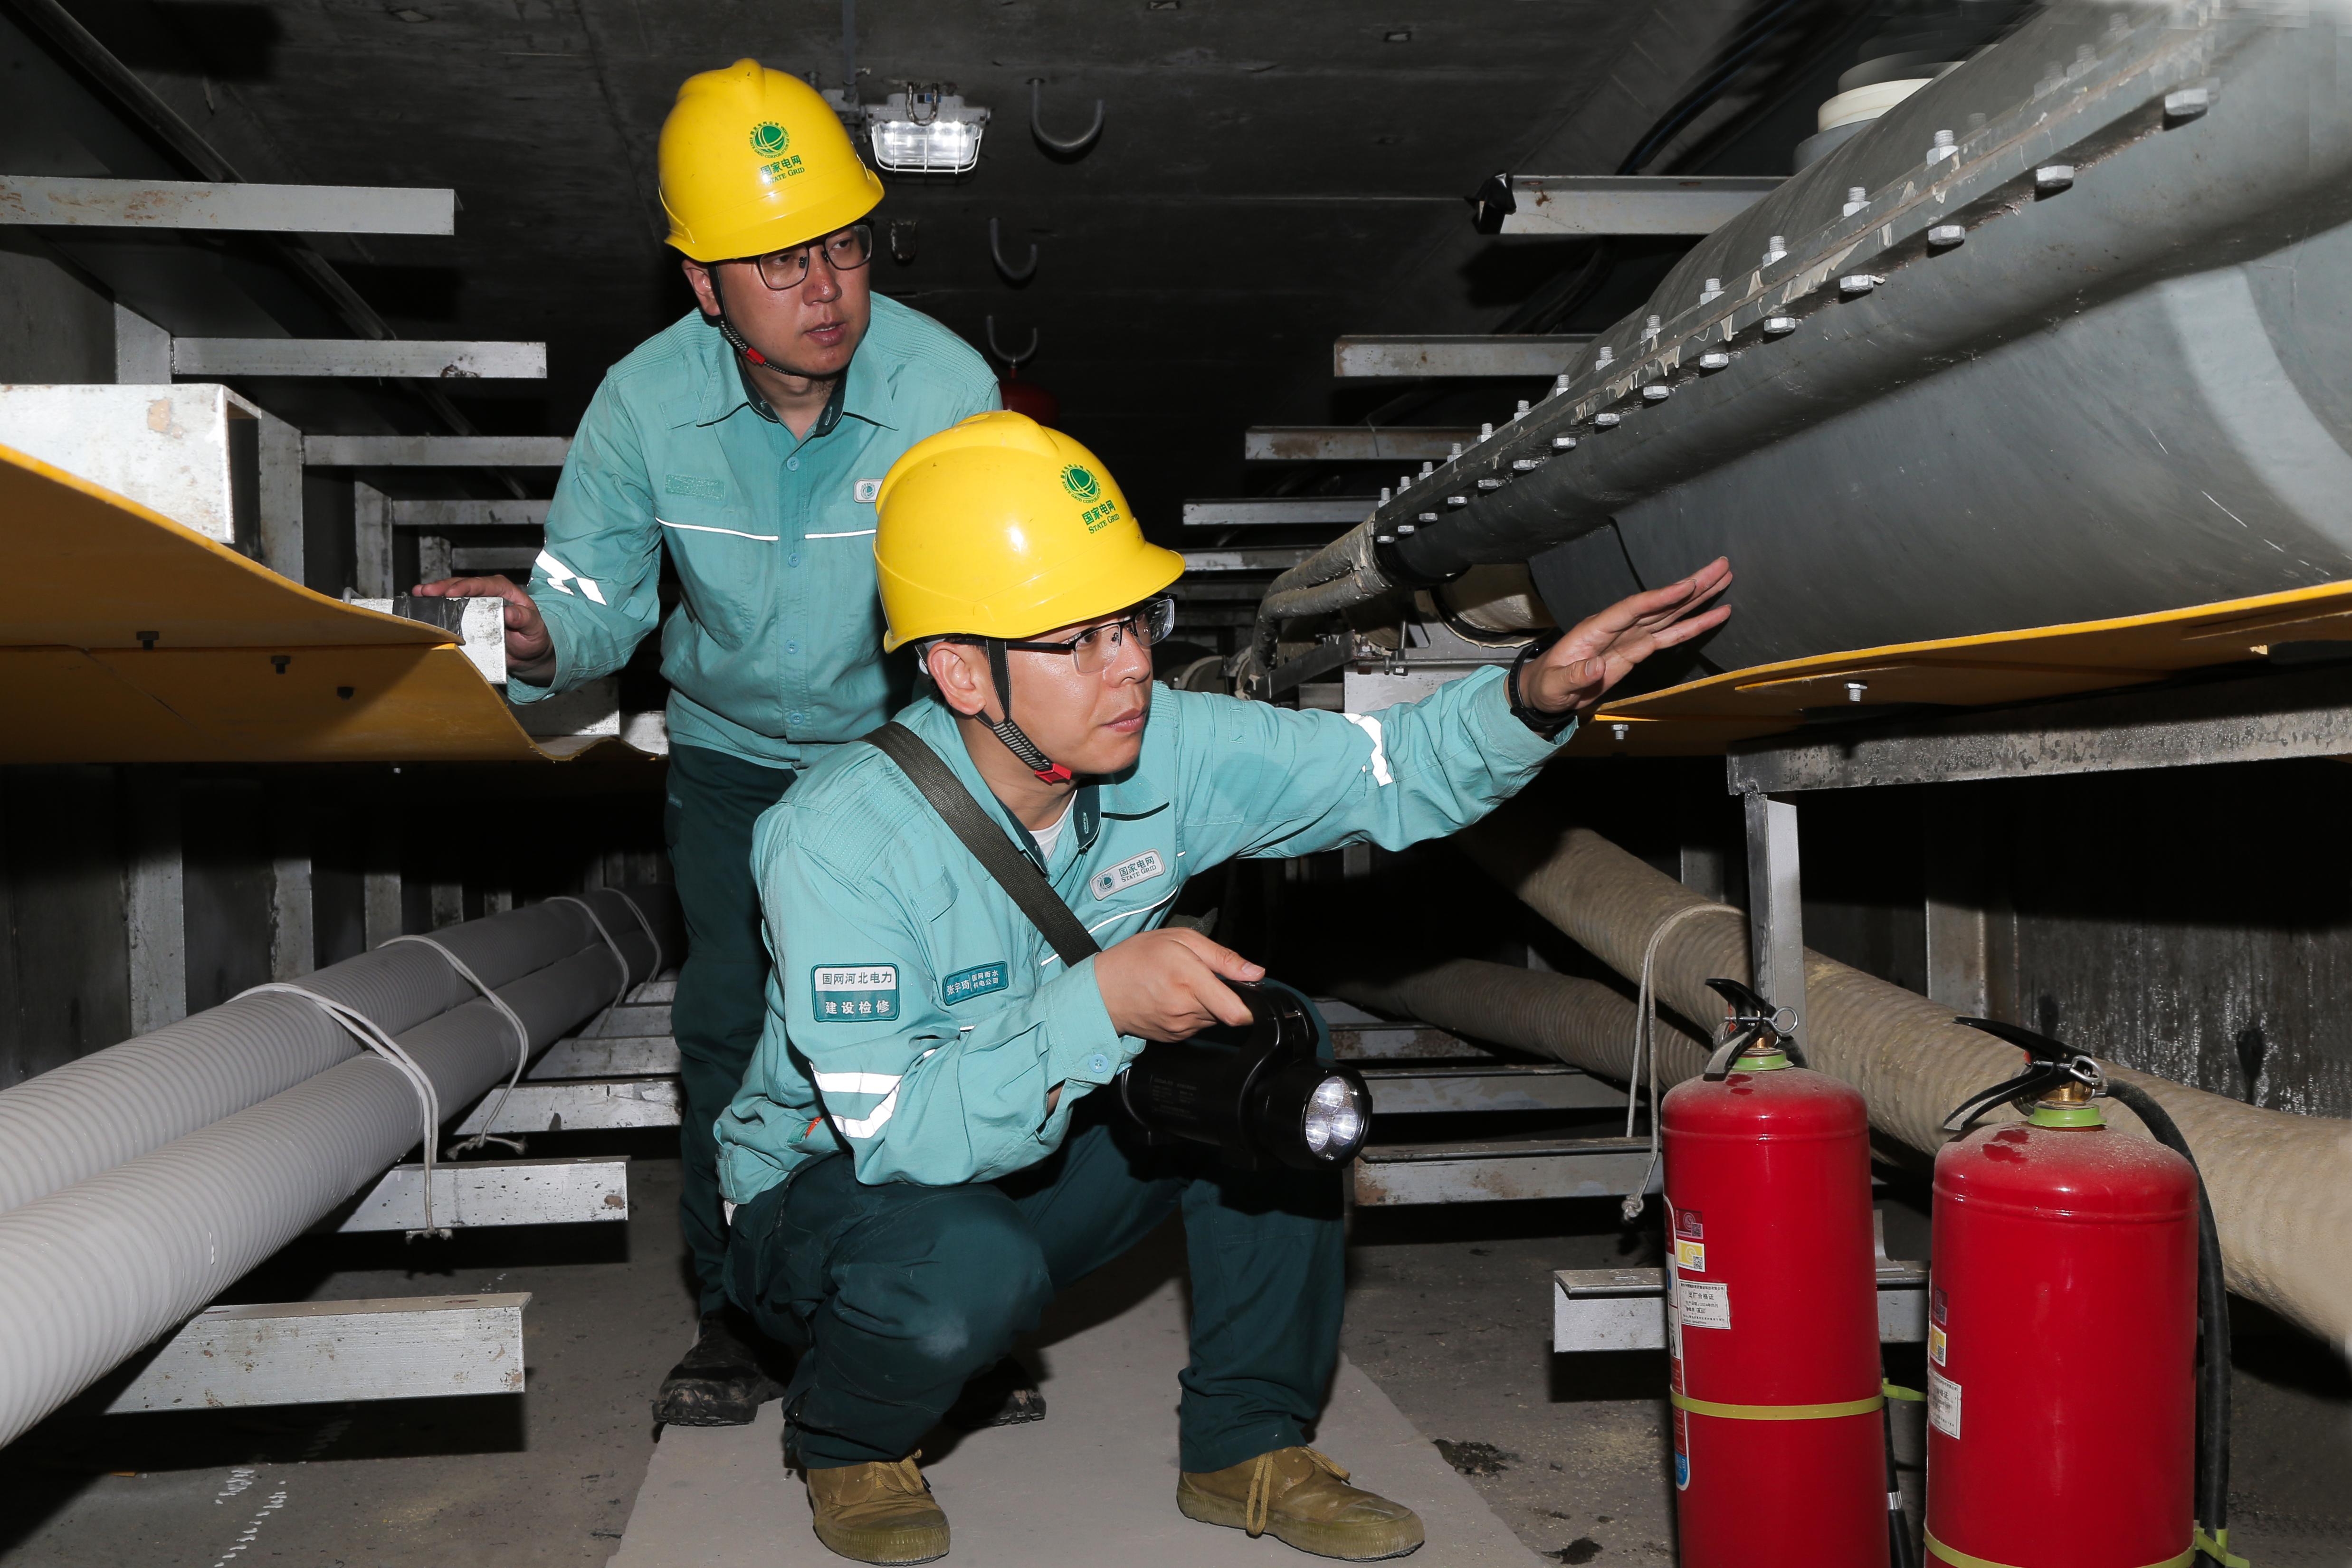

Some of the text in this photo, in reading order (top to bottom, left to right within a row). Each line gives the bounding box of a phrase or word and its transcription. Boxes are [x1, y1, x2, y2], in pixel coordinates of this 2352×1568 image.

[761, 155, 801, 175] 国家电网
[788, 167, 805, 176] GRID
[1082, 500, 1116, 525] 国家电网
[1088, 513, 1120, 534] STATE GRID
[1119, 856, 1154, 877] 国家电网
[1121, 865, 1156, 882] STATE GRID
[823, 971, 892, 985] 国网河北电力
[973, 977, 999, 988] 供电公司
[825, 1000, 890, 1015] 建设检修
